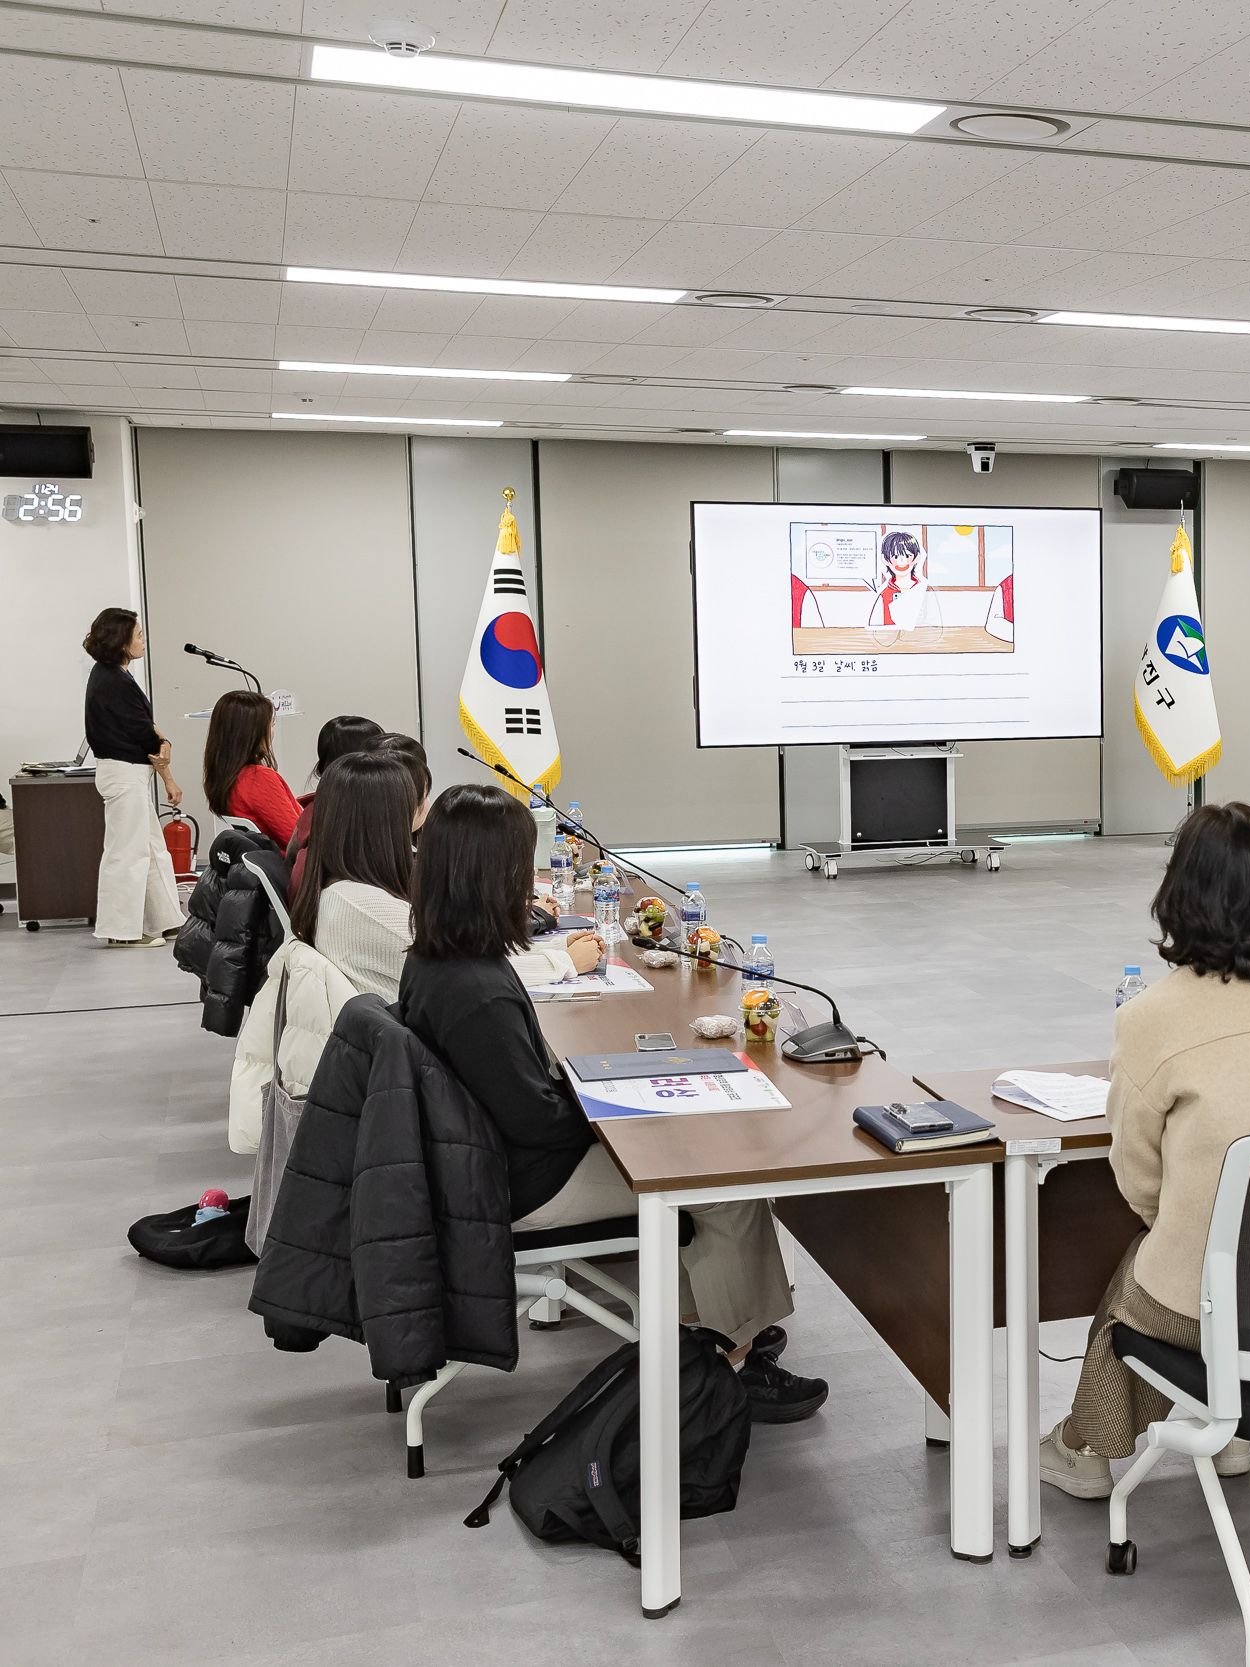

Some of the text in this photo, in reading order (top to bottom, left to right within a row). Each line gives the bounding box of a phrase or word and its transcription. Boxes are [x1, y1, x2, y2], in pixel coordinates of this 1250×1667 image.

[19, 493, 82, 522] 2:56
[793, 660, 807, 673] 9월
[812, 660, 826, 673] 3일
[1141, 642, 1176, 710] 진구
